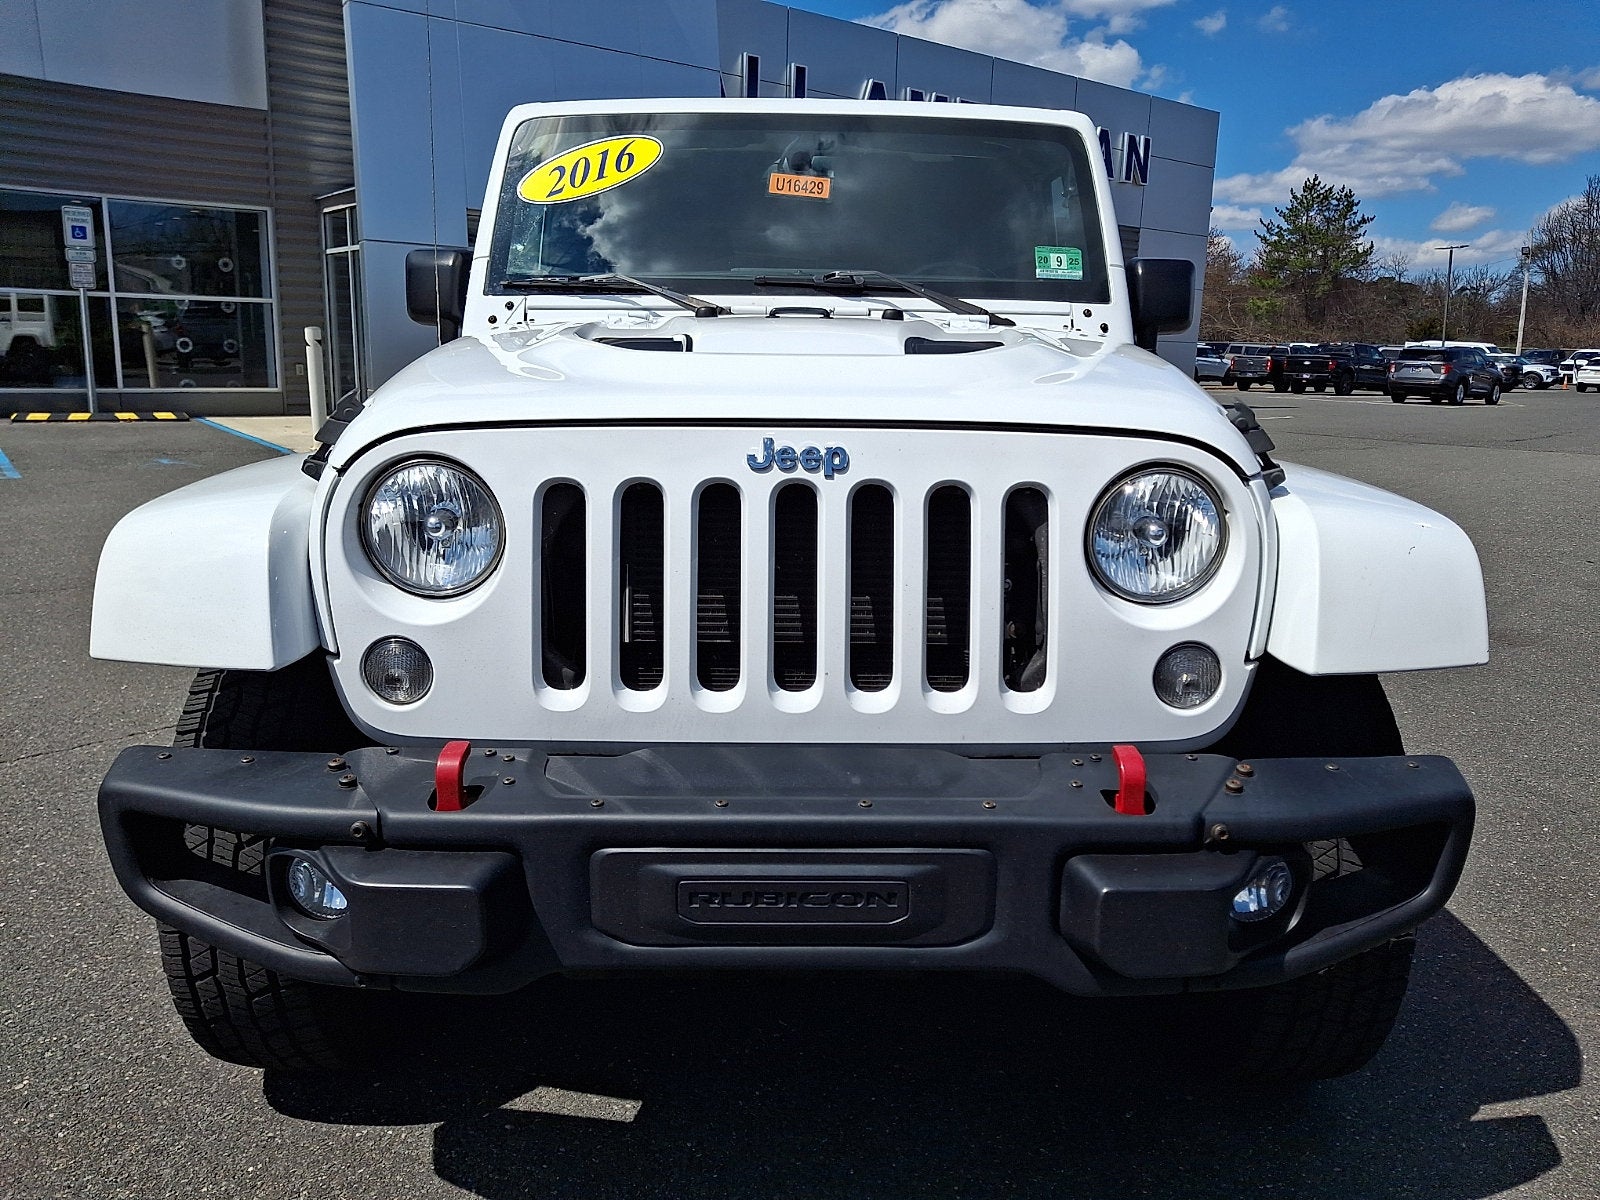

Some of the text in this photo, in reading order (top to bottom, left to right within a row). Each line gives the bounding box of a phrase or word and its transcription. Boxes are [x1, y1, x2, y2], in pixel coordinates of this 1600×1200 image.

[545, 139, 636, 198] 2016
[775, 177, 825, 196] U16429
[1038, 255, 1080, 267] 20 9 25
[746, 437, 850, 480] Jeep
[688, 891, 899, 909] RUBICON
